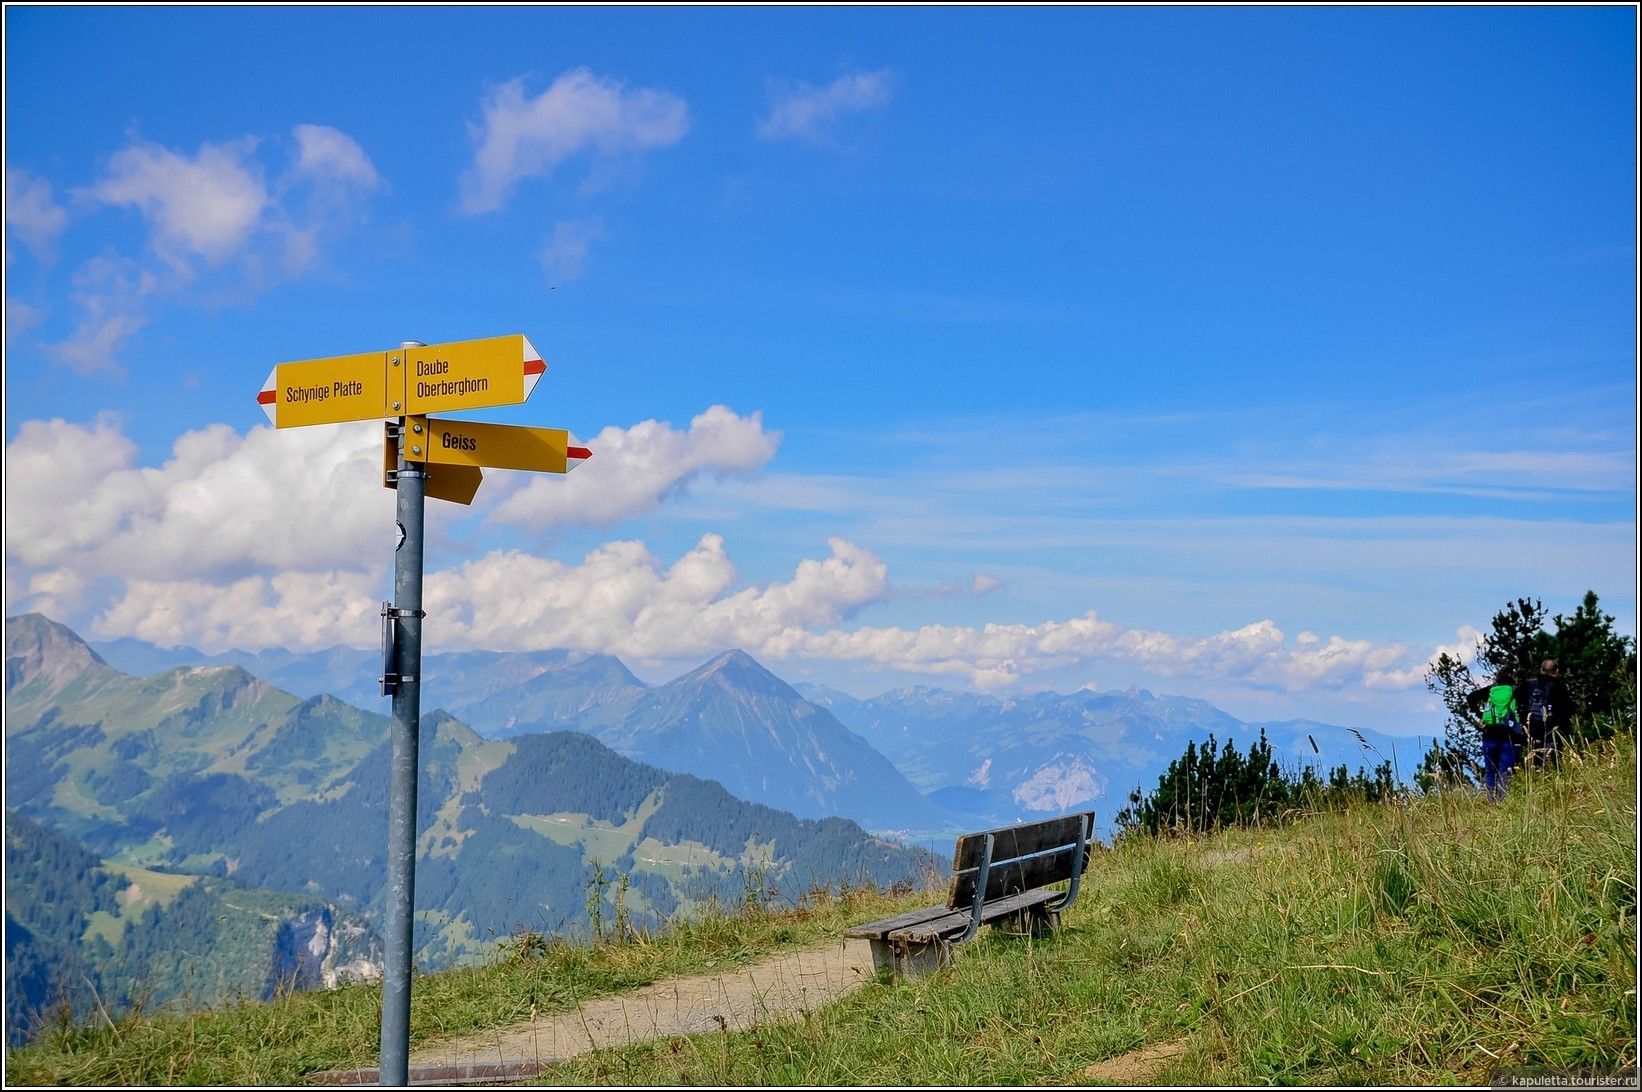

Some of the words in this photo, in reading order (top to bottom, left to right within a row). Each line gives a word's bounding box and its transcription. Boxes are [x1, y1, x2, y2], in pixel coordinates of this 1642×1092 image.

[417, 360, 449, 377] Daube
[286, 385, 330, 404] Schynige
[333, 380, 362, 398] Platte
[417, 377, 488, 398] Oberberghorn
[442, 432, 477, 451] Geiss
